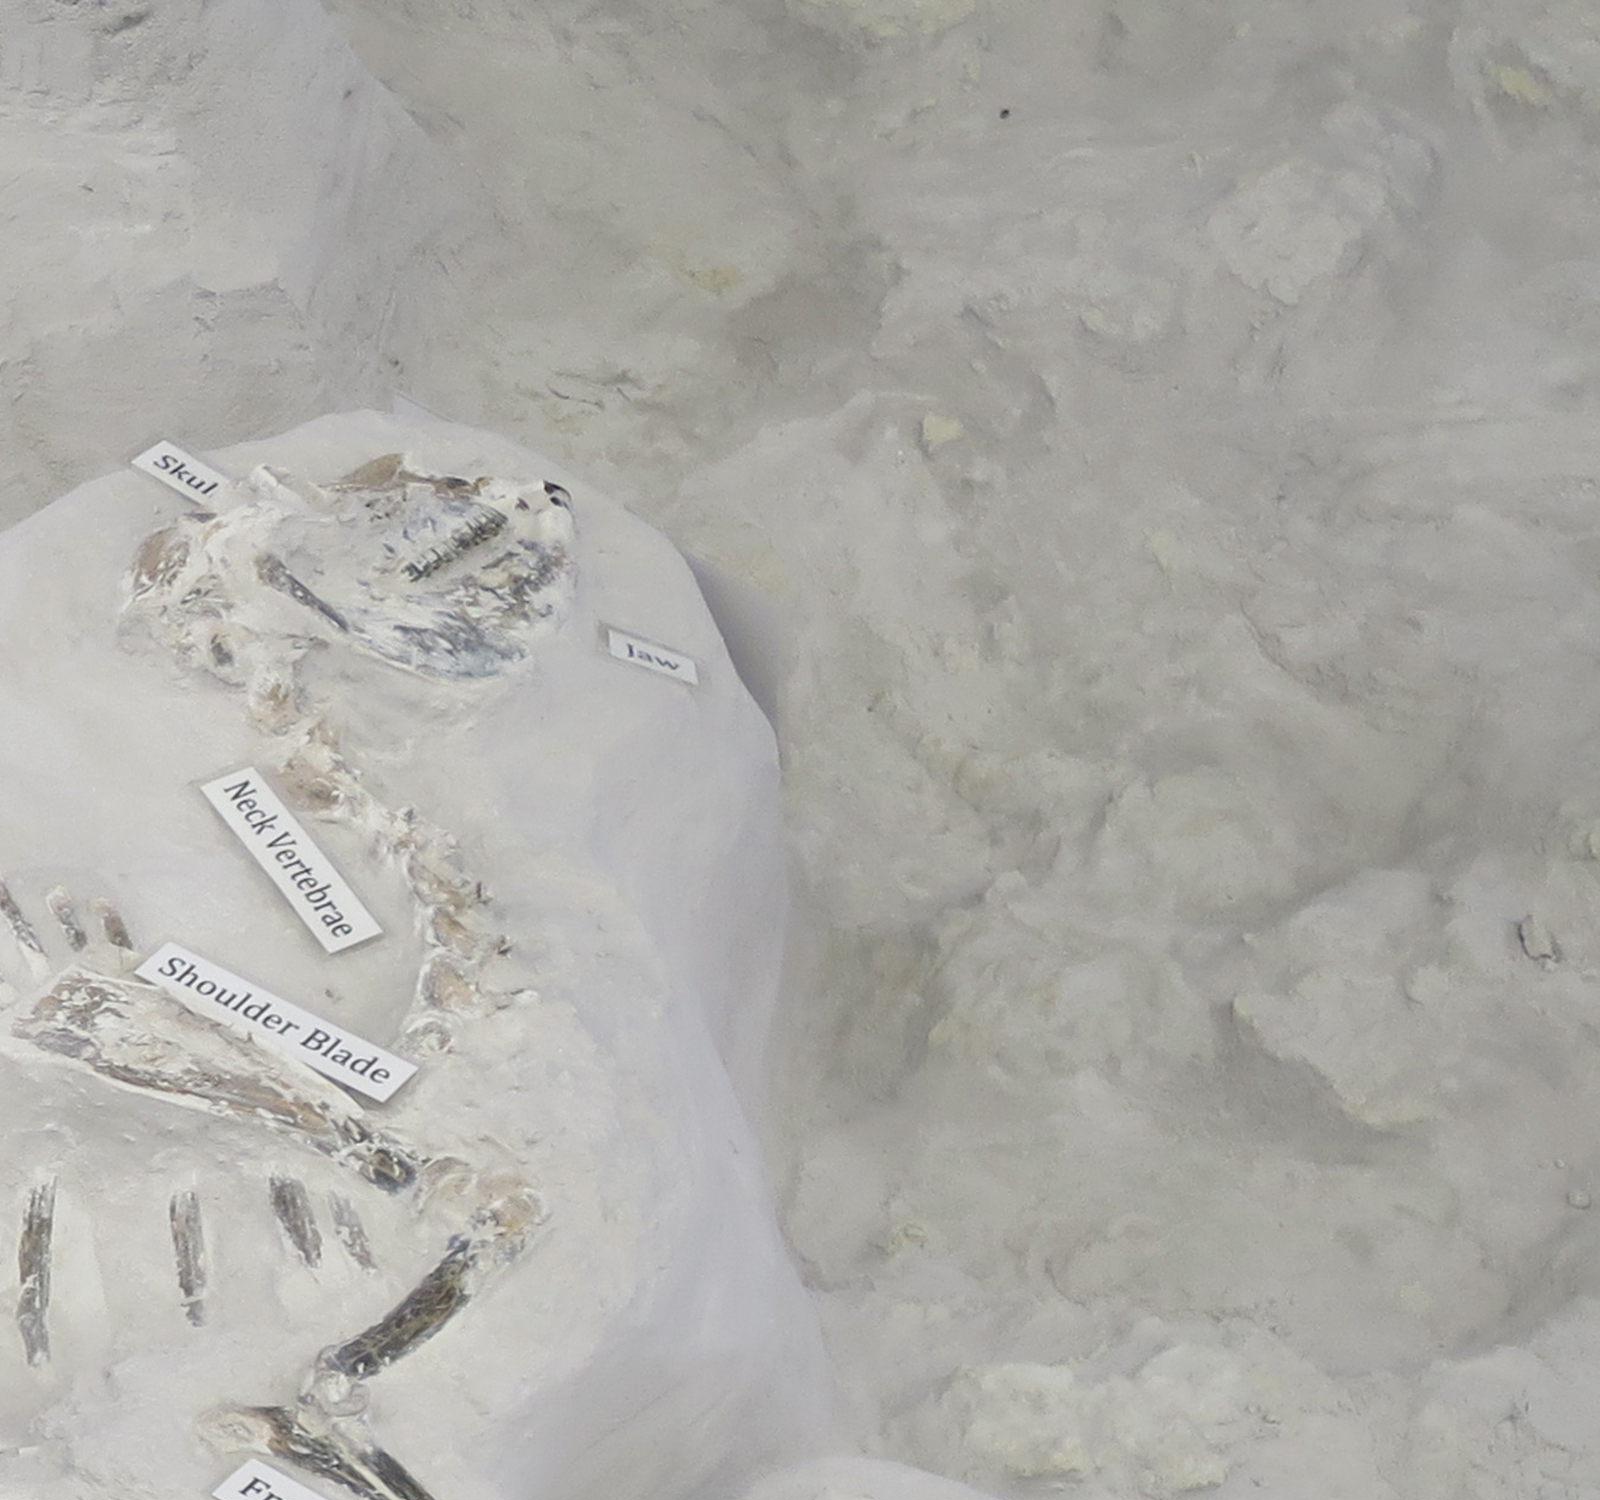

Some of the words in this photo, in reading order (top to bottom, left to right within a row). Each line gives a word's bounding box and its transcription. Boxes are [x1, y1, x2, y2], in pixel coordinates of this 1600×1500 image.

[153, 454, 219, 496] Skul
[223, 780, 279, 835] Neck
[266, 831, 353, 938] Vertebrae
[158, 956, 300, 1036] Shoulder
[300, 1028, 391, 1084] Blade
